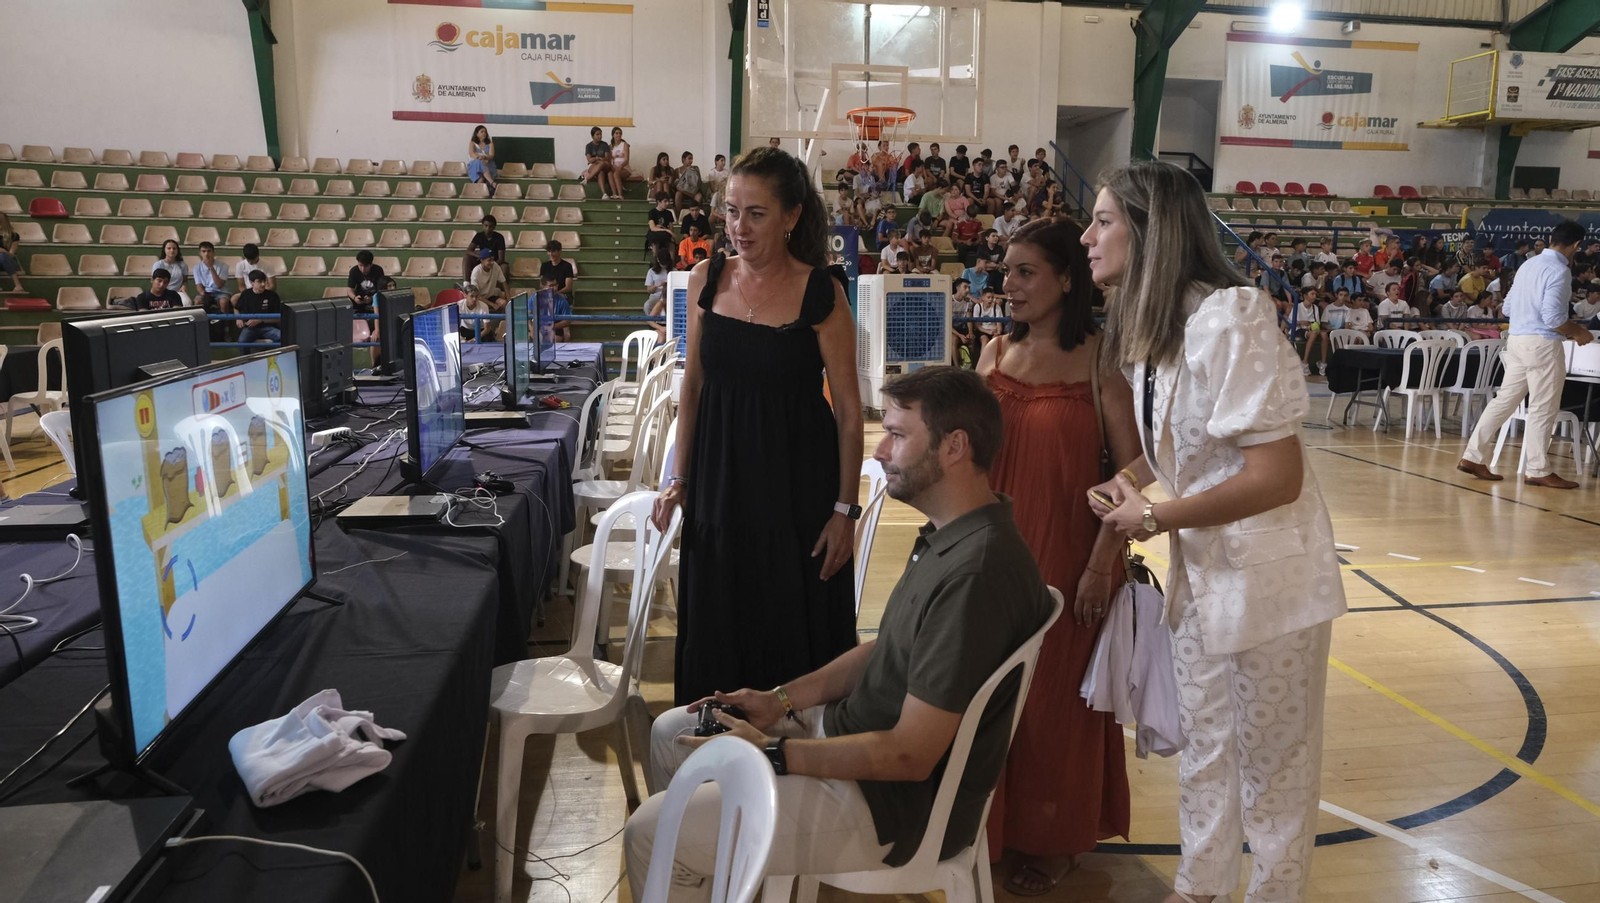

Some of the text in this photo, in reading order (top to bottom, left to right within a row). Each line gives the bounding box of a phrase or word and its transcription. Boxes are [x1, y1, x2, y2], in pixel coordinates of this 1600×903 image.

[465, 24, 576, 55] cajamar
[520, 53, 574, 62] CAJA RURAL
[1555, 67, 1576, 78] FASE
[437, 84, 486, 92] AYUNTAMIENTO
[1337, 112, 1398, 132] cajamar
